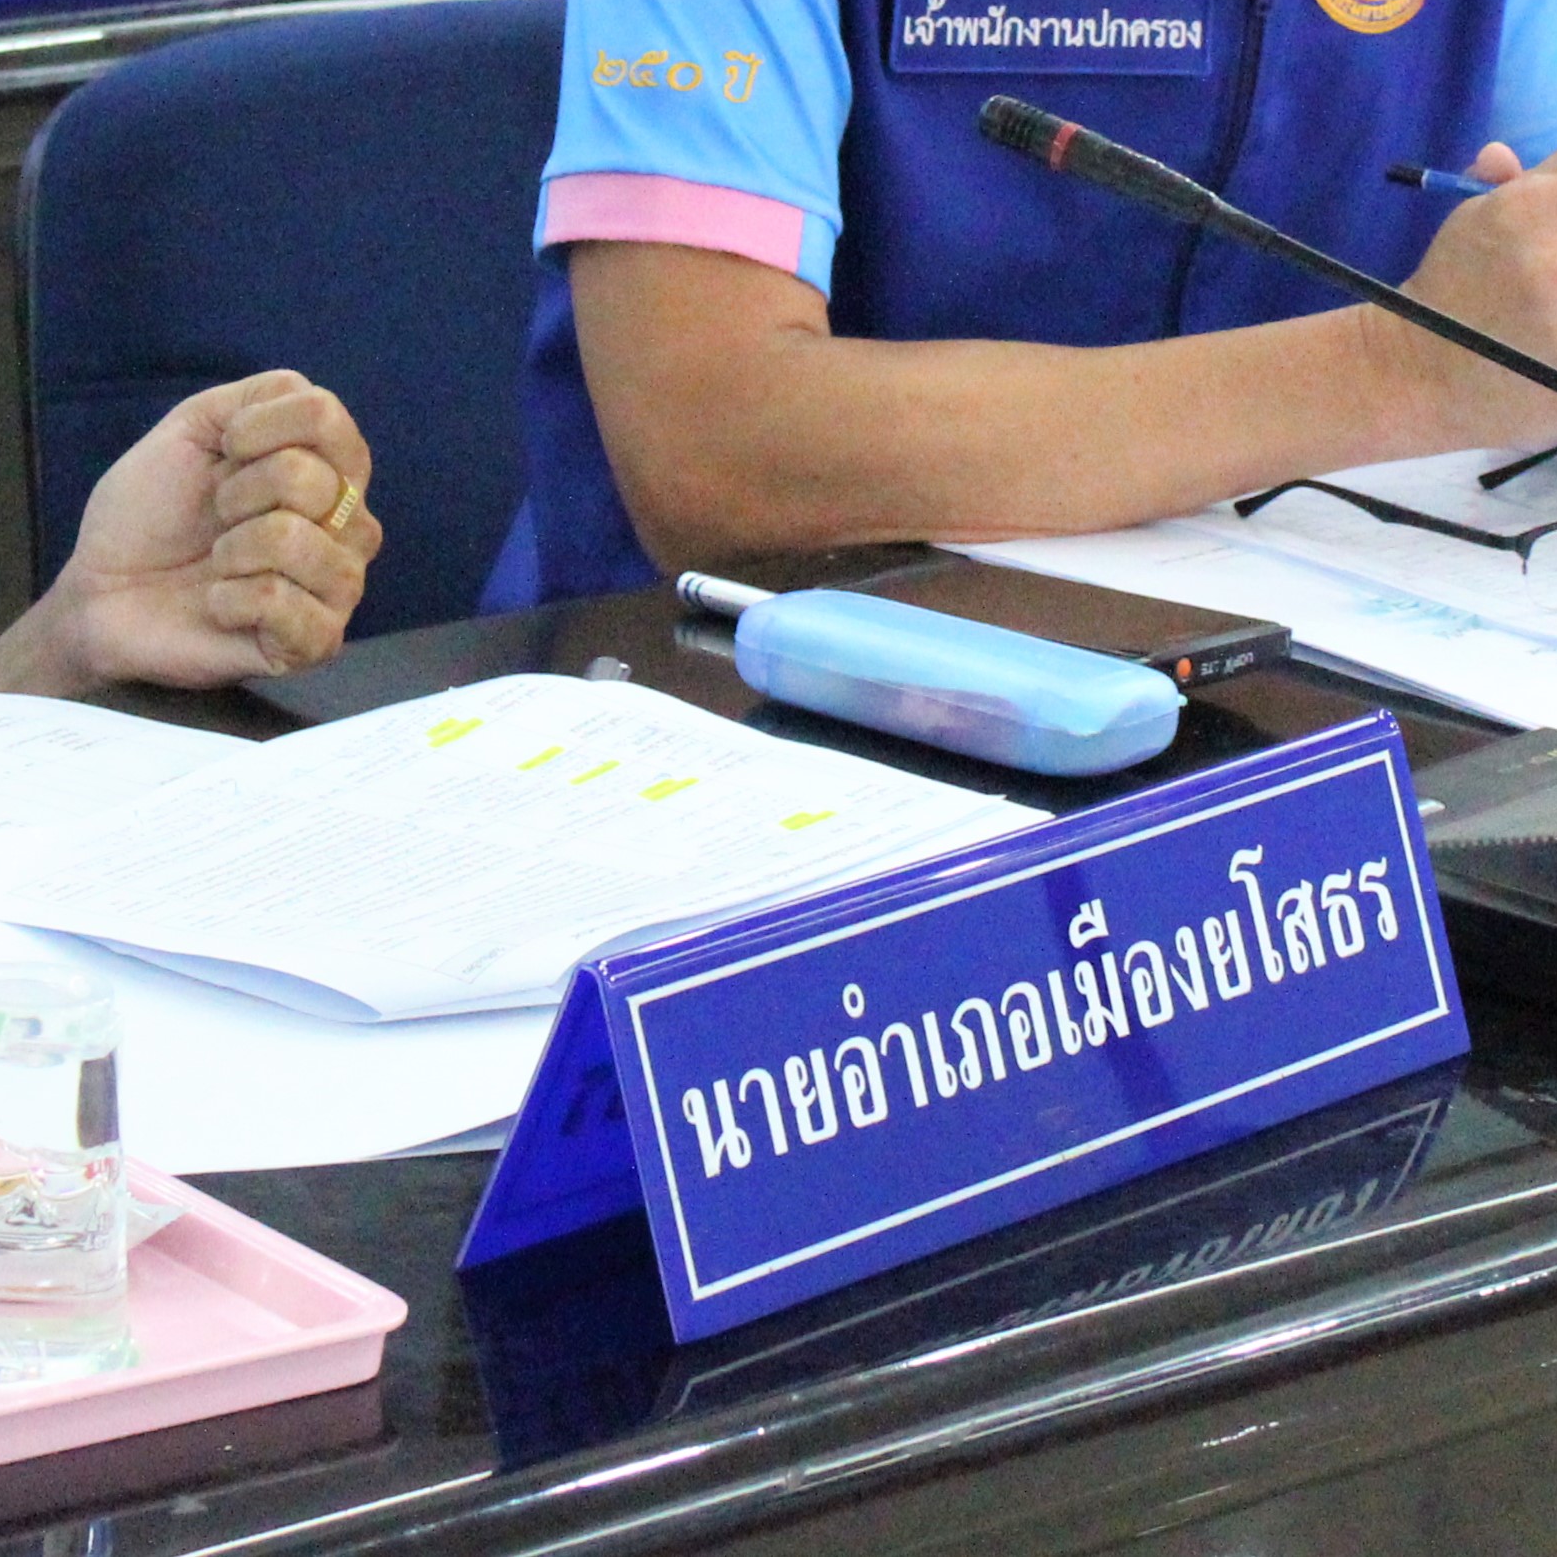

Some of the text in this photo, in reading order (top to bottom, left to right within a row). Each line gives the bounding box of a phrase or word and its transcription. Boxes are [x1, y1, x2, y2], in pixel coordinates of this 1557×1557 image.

[723, 50, 763, 103] ปี
[681, 844, 1400, 1179] นายอำเภอเมืองยโสธร
